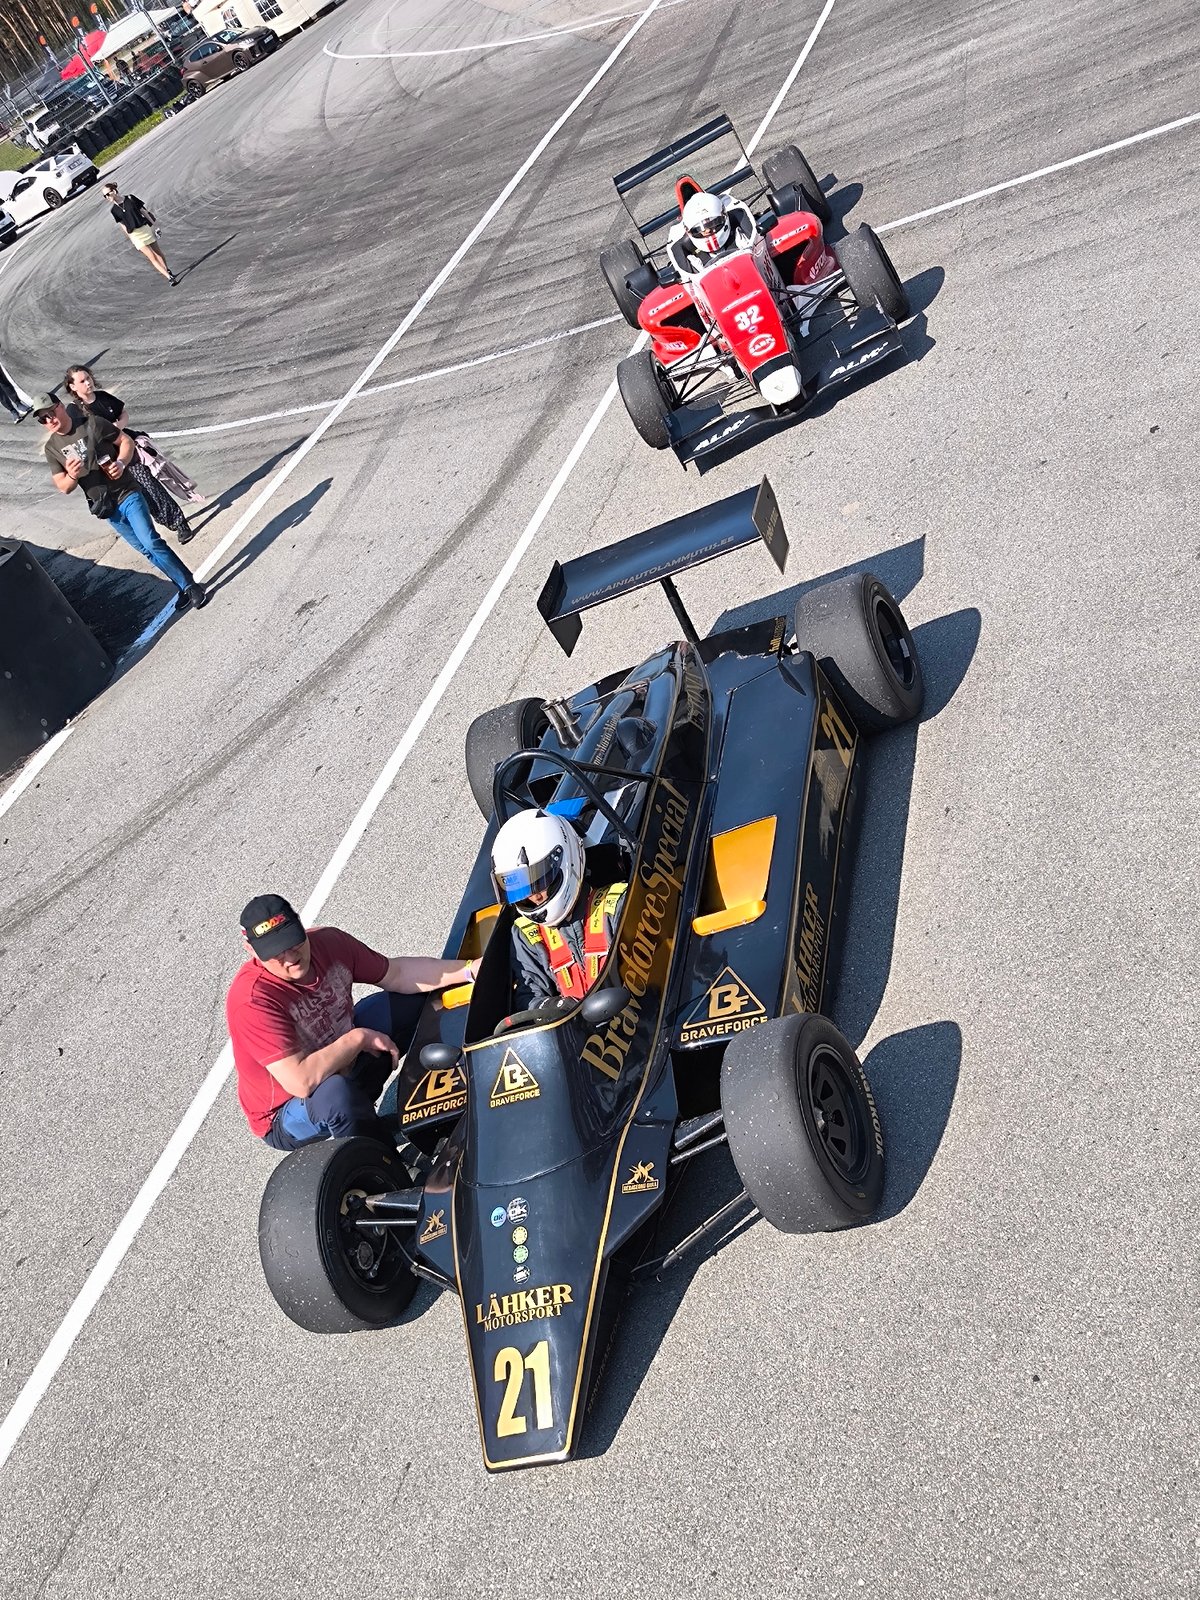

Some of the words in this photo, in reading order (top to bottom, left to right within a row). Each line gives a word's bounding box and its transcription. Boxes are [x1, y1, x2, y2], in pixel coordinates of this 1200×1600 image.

[734, 304, 764, 331] 32
[821, 697, 853, 769] 21
[490, 1089, 540, 1108] BRAVEFORCE
[476, 1283, 574, 1324] LÄHKER
[484, 1304, 563, 1333] MOTORSPORT
[493, 1340, 554, 1439] 21
